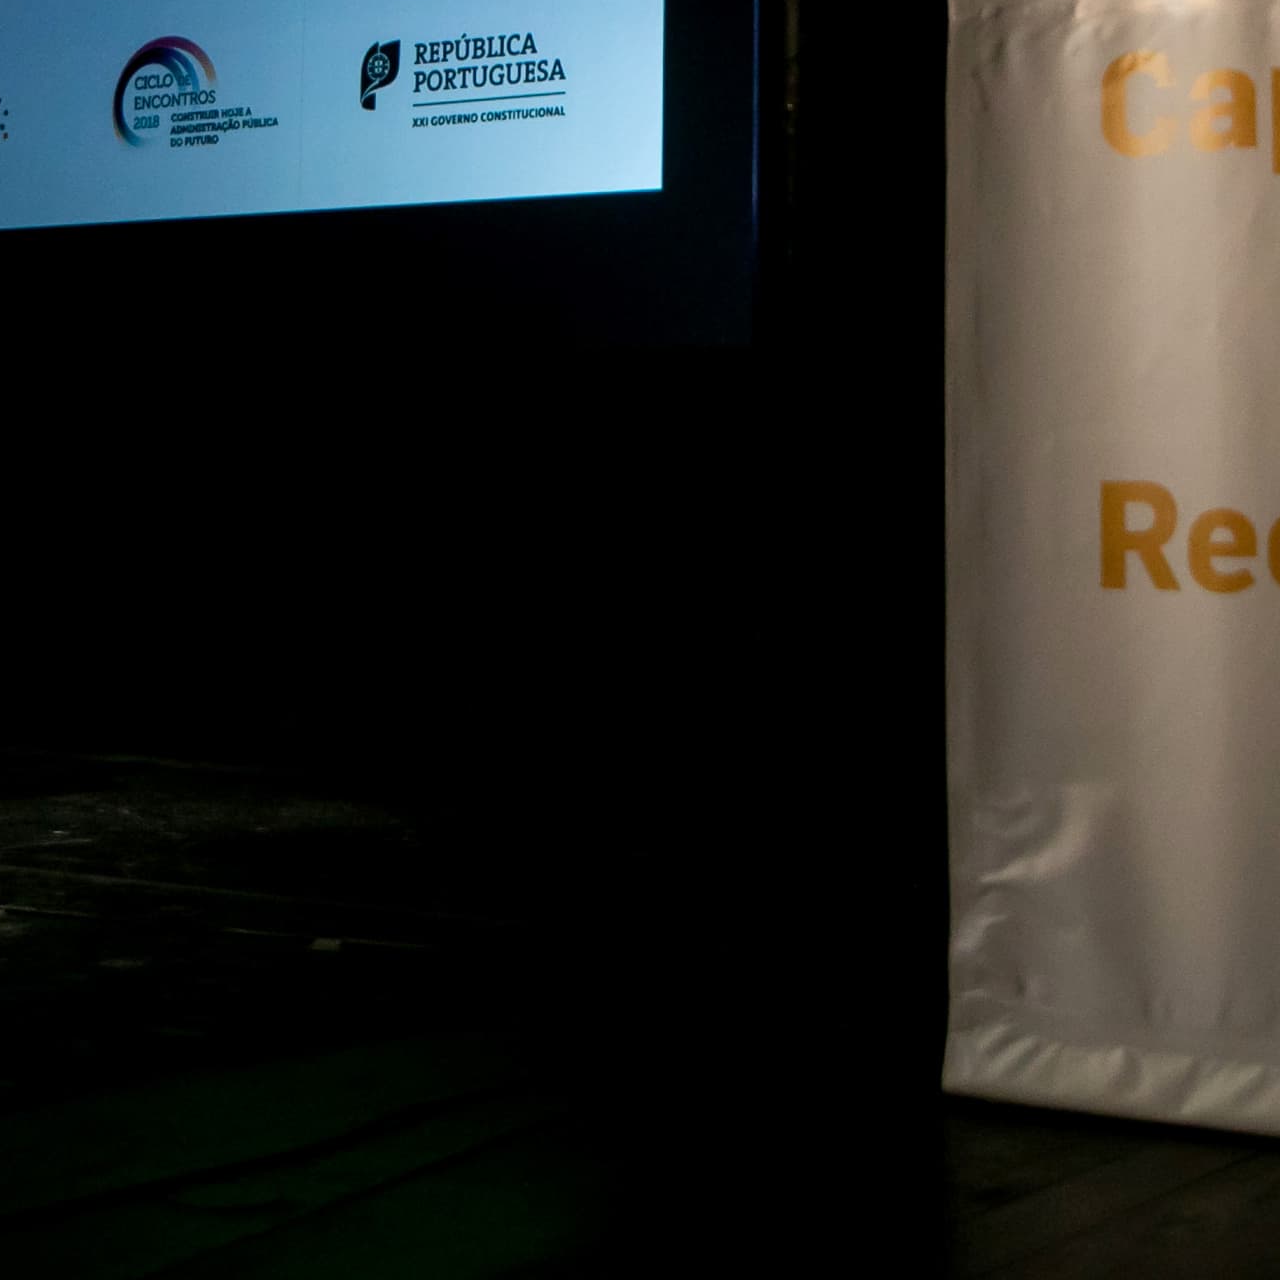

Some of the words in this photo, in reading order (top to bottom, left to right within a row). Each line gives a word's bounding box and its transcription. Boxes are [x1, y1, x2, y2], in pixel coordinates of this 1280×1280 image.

[413, 32, 538, 65] REPÚBLICA
[134, 73, 173, 90] CICLO
[412, 58, 566, 93] PORTUGUESA
[133, 90, 216, 111] ENCONTROS
[133, 114, 160, 130] 2018
[412, 116, 429, 128] XXI
[430, 113, 479, 127] GOVERNO
[480, 106, 566, 123] CONSTITUCIONAL
[170, 137, 183, 148] DO
[184, 135, 220, 147] FUTURO
